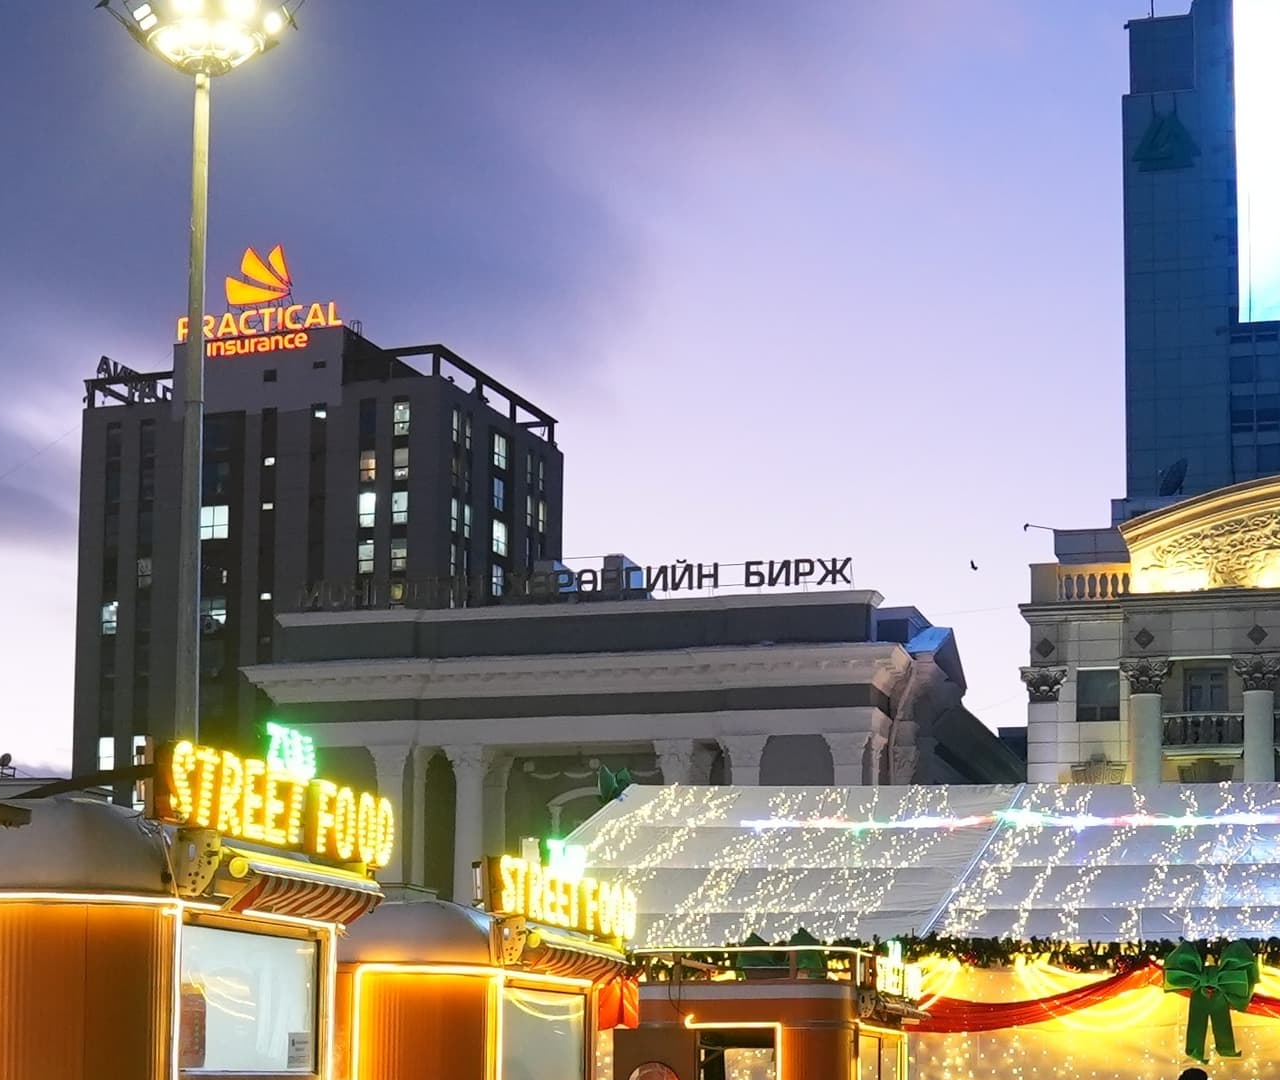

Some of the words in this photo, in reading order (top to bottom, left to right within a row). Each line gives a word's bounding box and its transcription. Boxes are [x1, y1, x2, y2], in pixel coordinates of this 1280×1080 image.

[177, 302, 343, 342] PRACTICAL
[206, 331, 309, 358] insurance
[744, 557, 852, 587] БИРЖ
[172, 740, 310, 846] STREET
[316, 778, 395, 867] FOOD
[500, 855, 581, 928] STREET
[583, 878, 638, 940] FOOD
